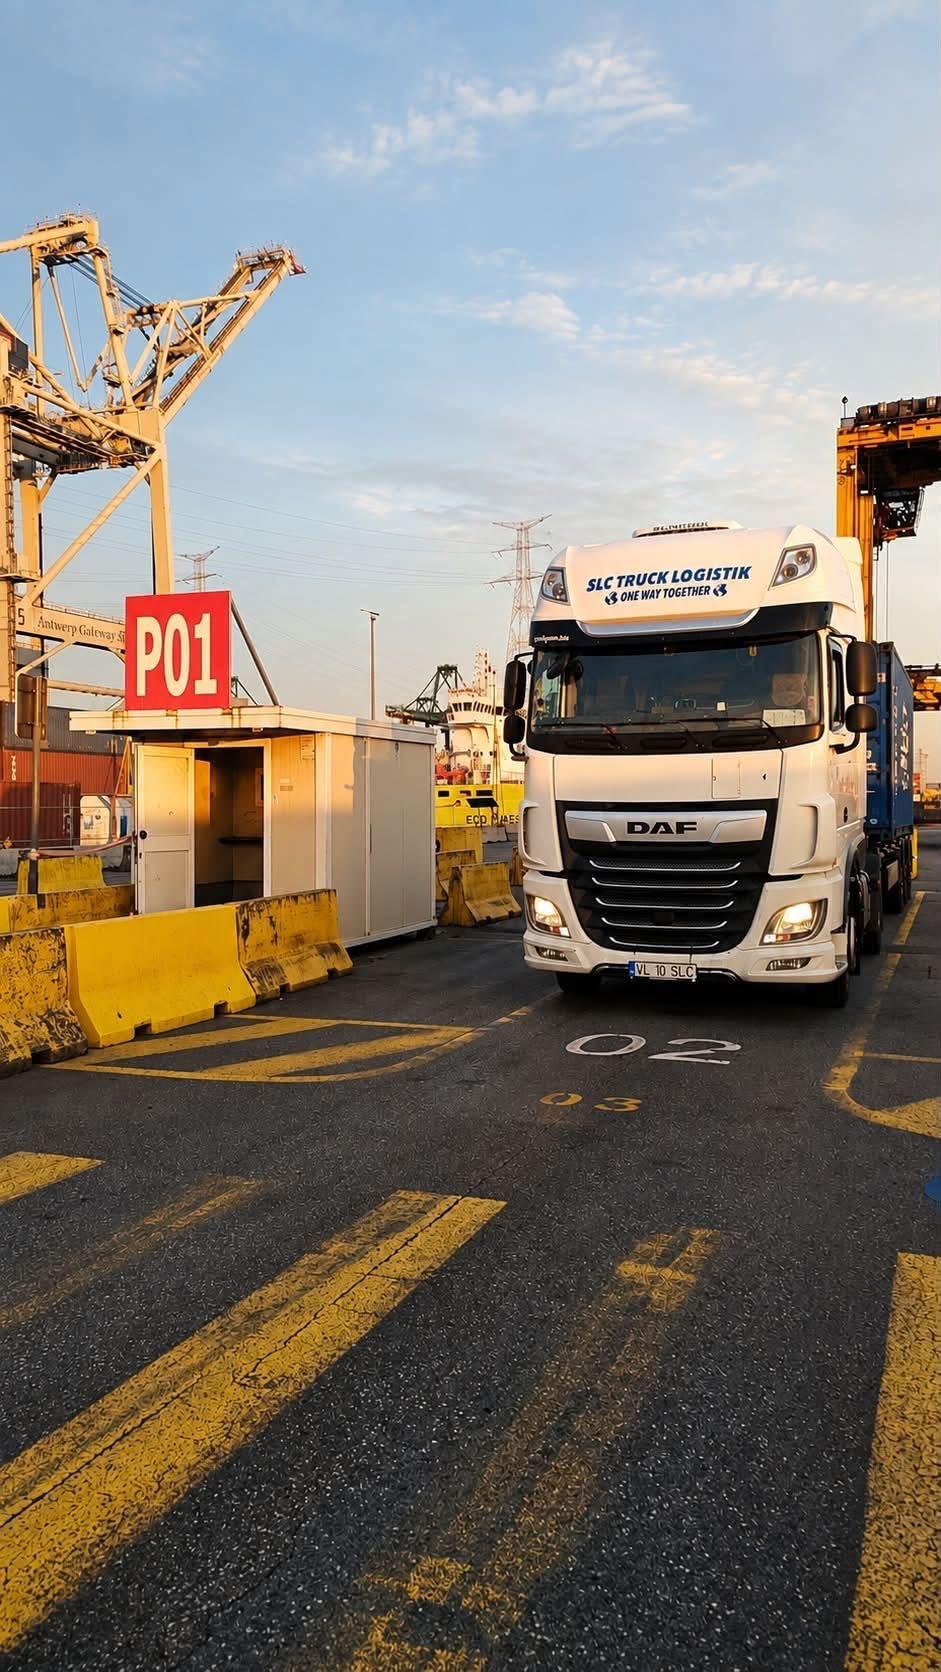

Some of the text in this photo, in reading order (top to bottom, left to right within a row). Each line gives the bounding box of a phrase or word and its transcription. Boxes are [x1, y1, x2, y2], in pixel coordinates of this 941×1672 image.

[586, 566, 752, 592] SLC TRUCK LOGISTIK
[620, 585, 710, 602] ONE WAY TOGETHER
[37, 615, 77, 637] Antwerp
[79, 624, 116, 643] Gateway
[136, 612, 218, 697] P01
[627, 822, 697, 834] DAF
[636, 963, 694, 978] VL 10 SLC
